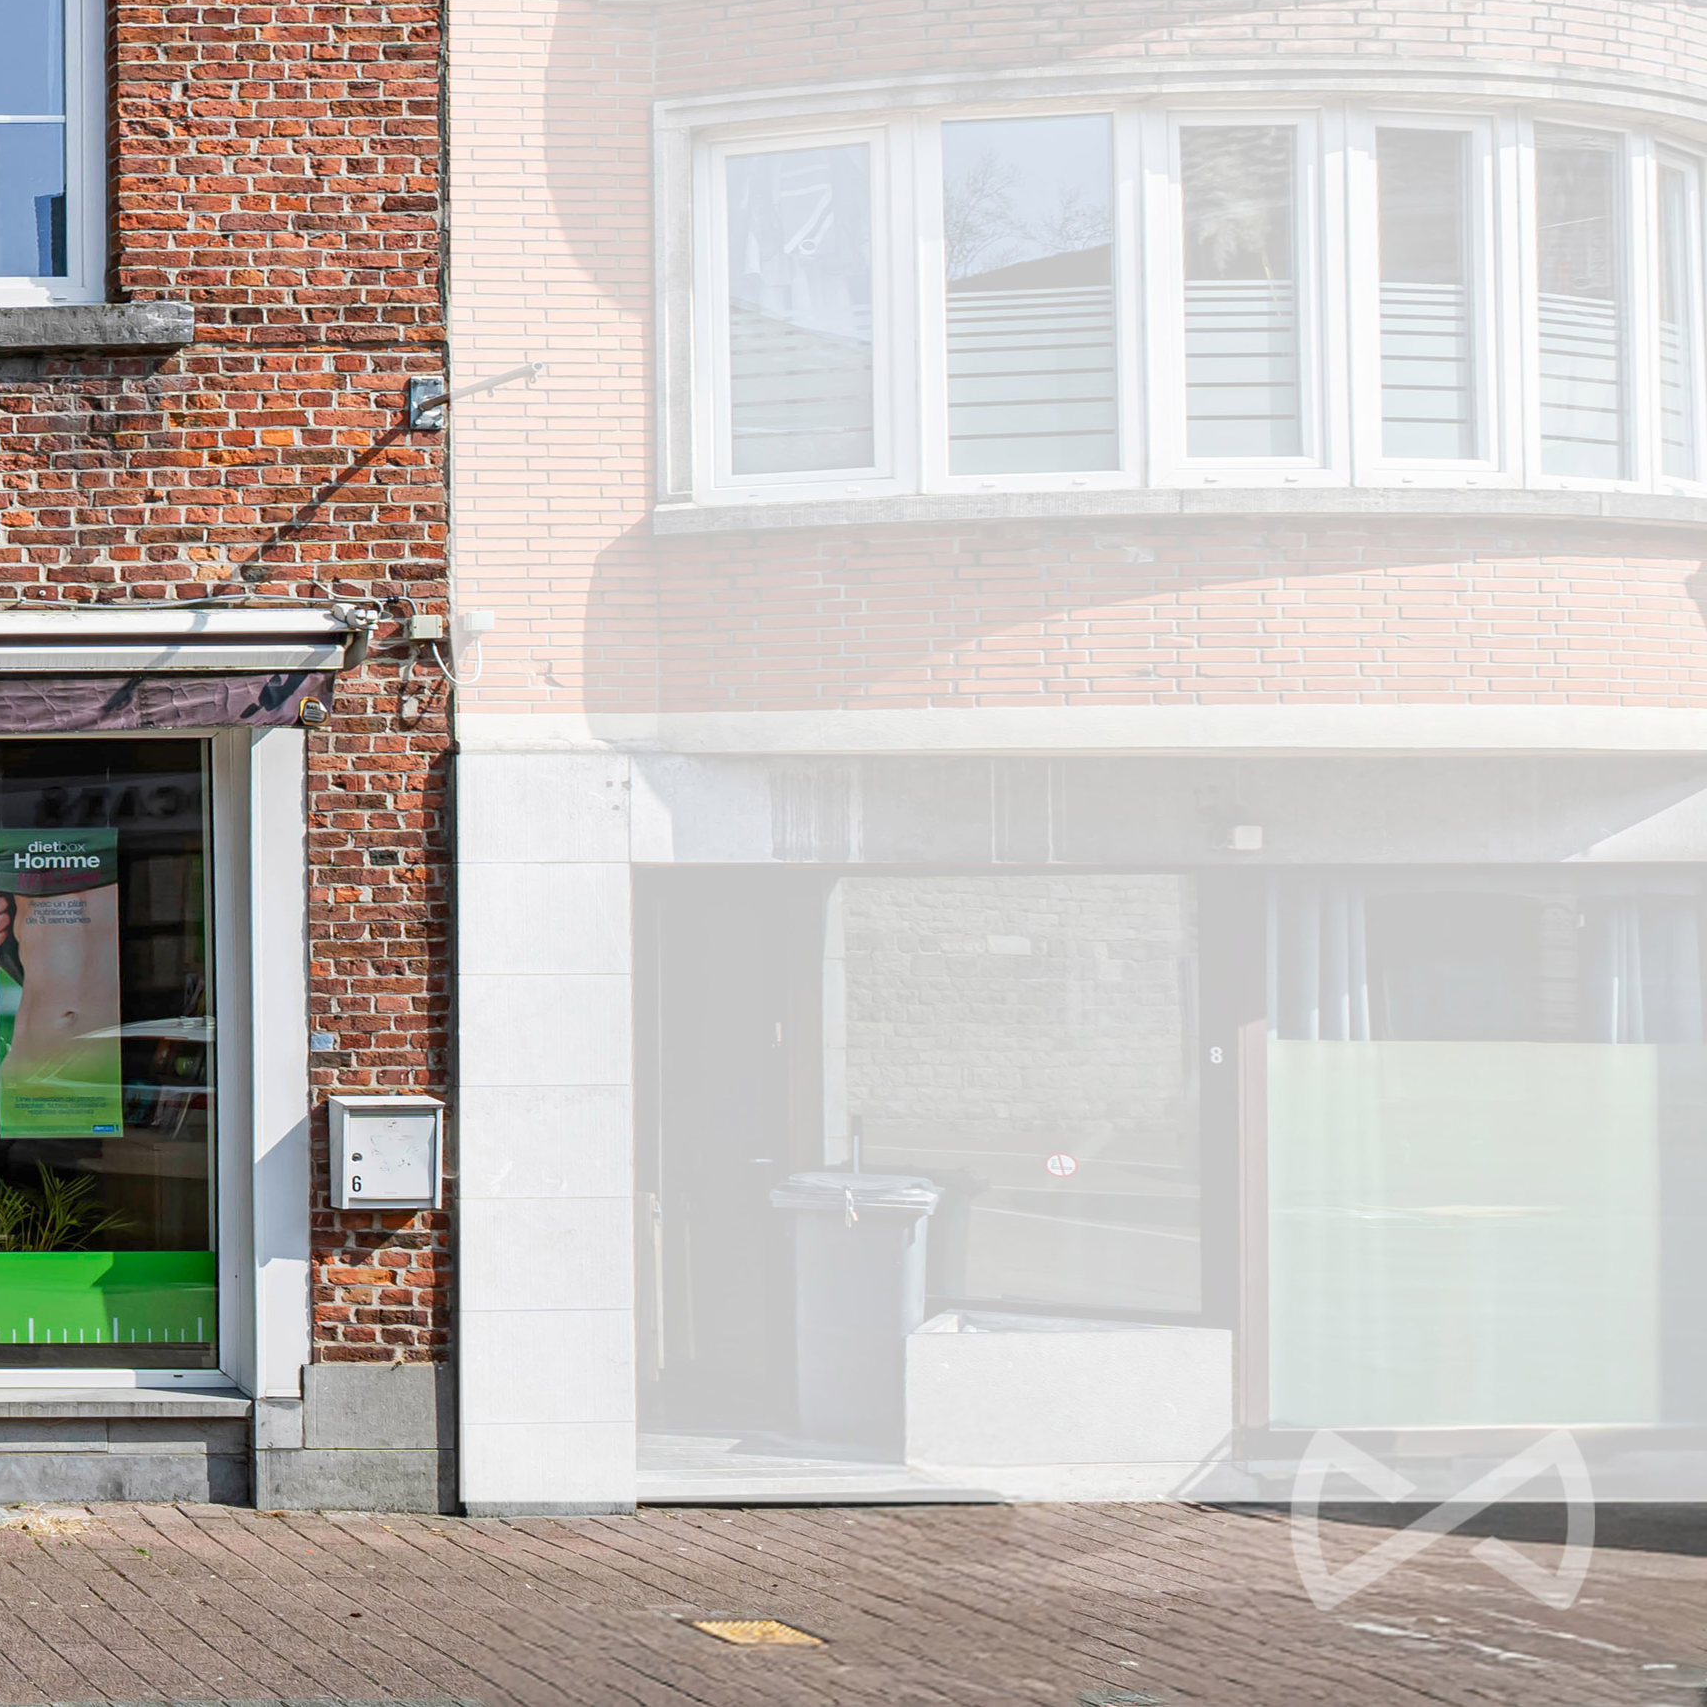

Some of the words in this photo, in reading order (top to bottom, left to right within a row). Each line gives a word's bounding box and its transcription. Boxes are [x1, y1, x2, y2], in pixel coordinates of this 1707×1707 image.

[28, 841, 86, 854] dietbox
[14, 852, 101, 870] Homme
[1210, 1046, 1223, 1064] 8
[351, 1175, 362, 1192] 6
